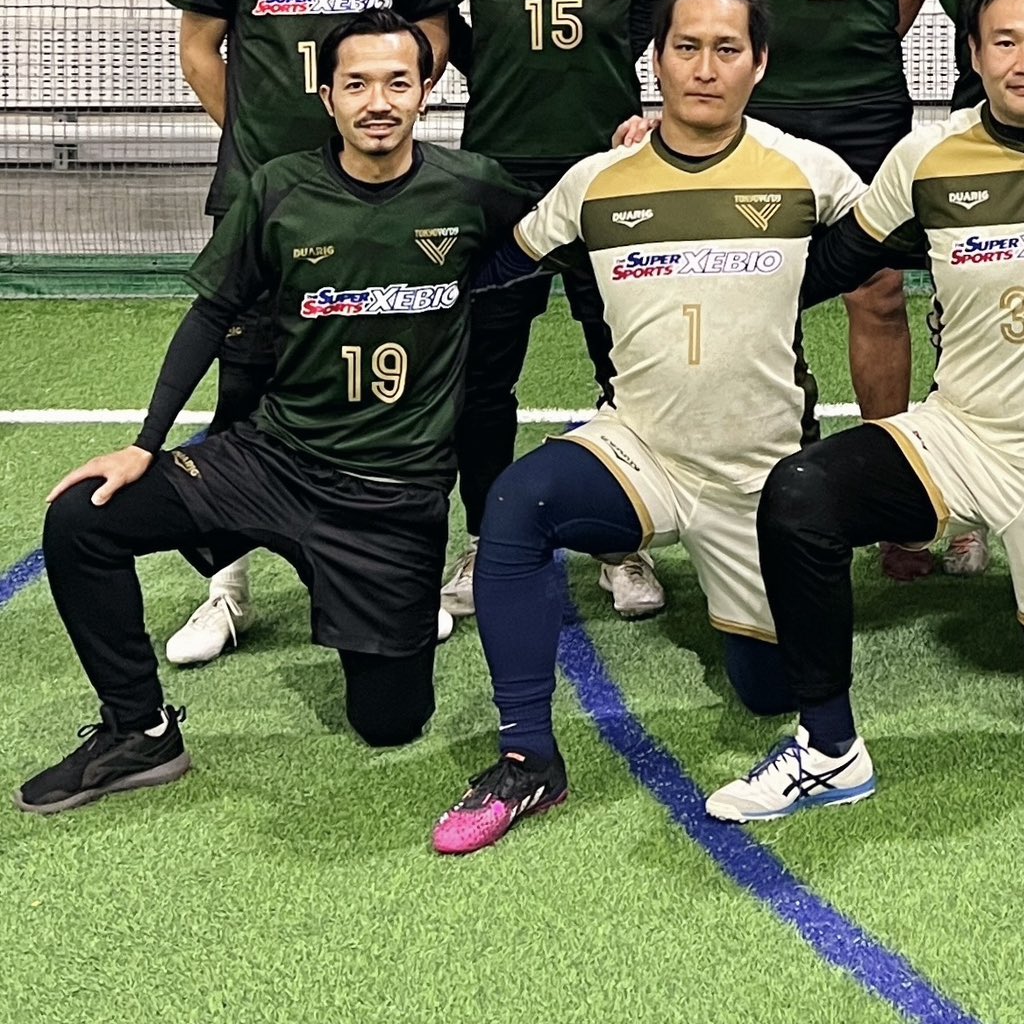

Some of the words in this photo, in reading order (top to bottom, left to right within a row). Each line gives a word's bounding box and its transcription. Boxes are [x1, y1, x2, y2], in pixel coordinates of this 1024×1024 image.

[252, 1, 308, 14] SPORTS
[949, 190, 989, 203] DUARIG
[612, 208, 654, 222] DUARIG
[965, 236, 1019, 252] SUPER
[293, 246, 334, 259] DUARIG
[626, 252, 681, 267] SUPER
[951, 249, 1013, 264] SPORTS
[678, 249, 782, 273] XEBIO
[612, 265, 672, 280] SPORTS
[318, 288, 369, 304] SUPER
[302, 301, 363, 316] SPORTS
[682, 304, 701, 365] 1
[342, 342, 408, 404] 19
